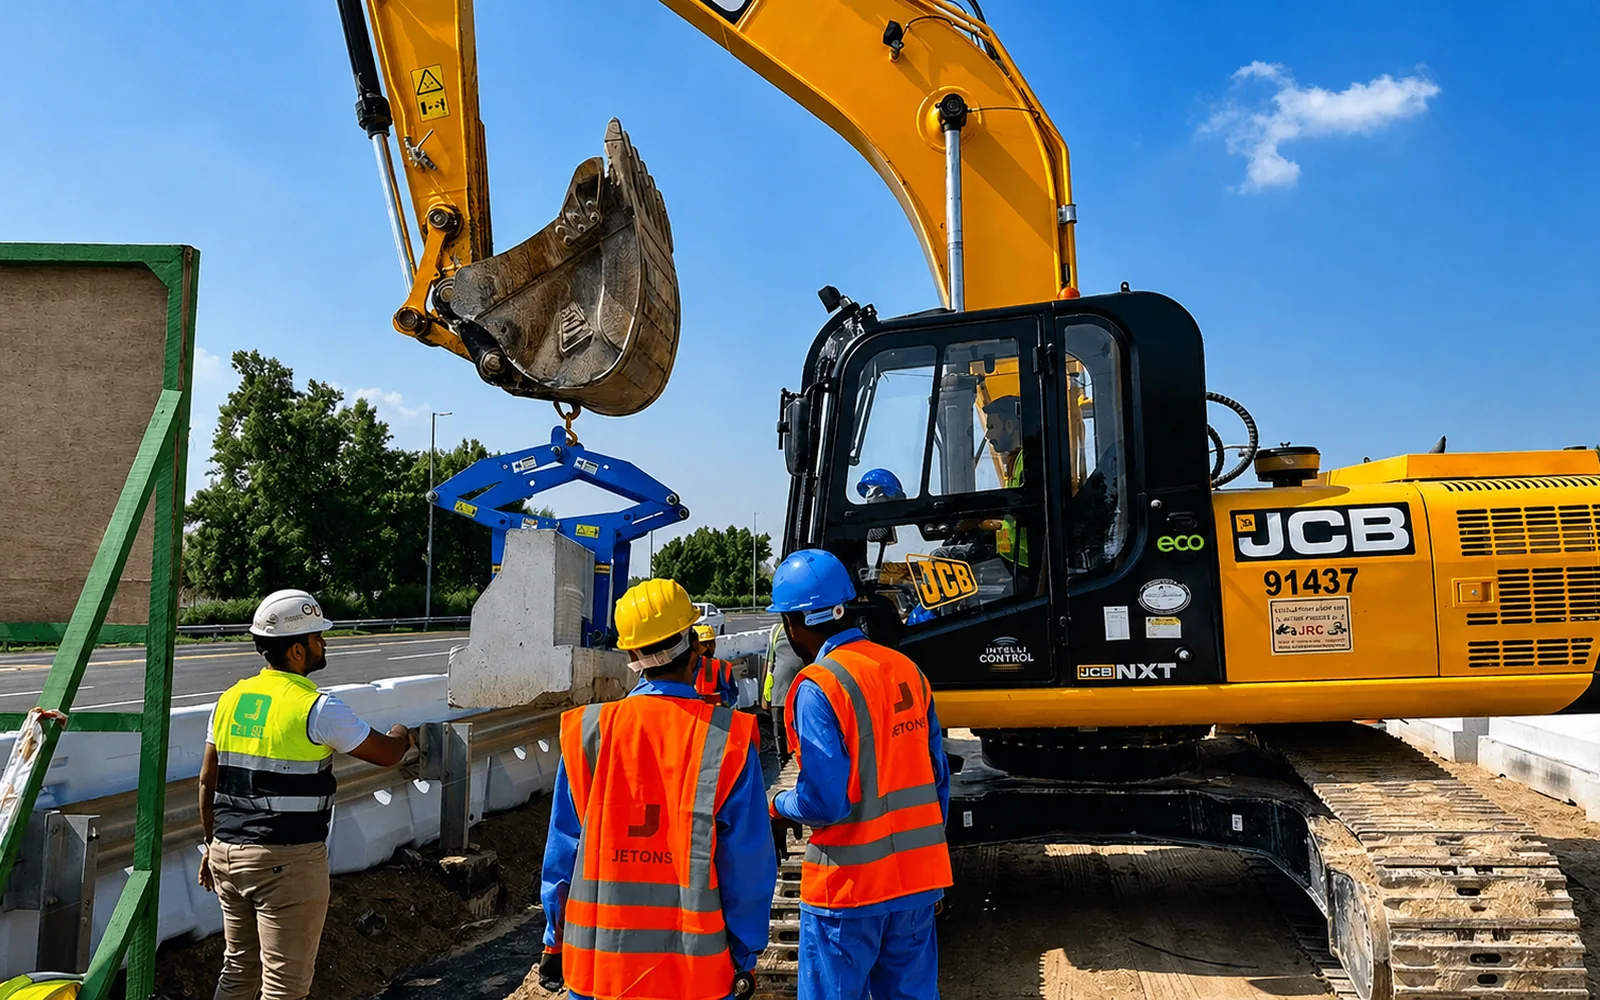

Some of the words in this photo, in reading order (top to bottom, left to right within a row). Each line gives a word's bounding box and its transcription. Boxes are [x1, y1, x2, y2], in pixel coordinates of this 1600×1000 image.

[1238, 507, 1410, 558] JCB
[1157, 535, 1204, 552] eco
[917, 561, 973, 604] JCB
[1263, 567, 1359, 597] 91437
[1298, 624, 1324, 636] JRC
[979, 652, 1034, 663] CONTROL
[1080, 667, 1112, 677] JCB
[1116, 662, 1177, 680] NXT
[611, 848, 673, 865] JETONS
